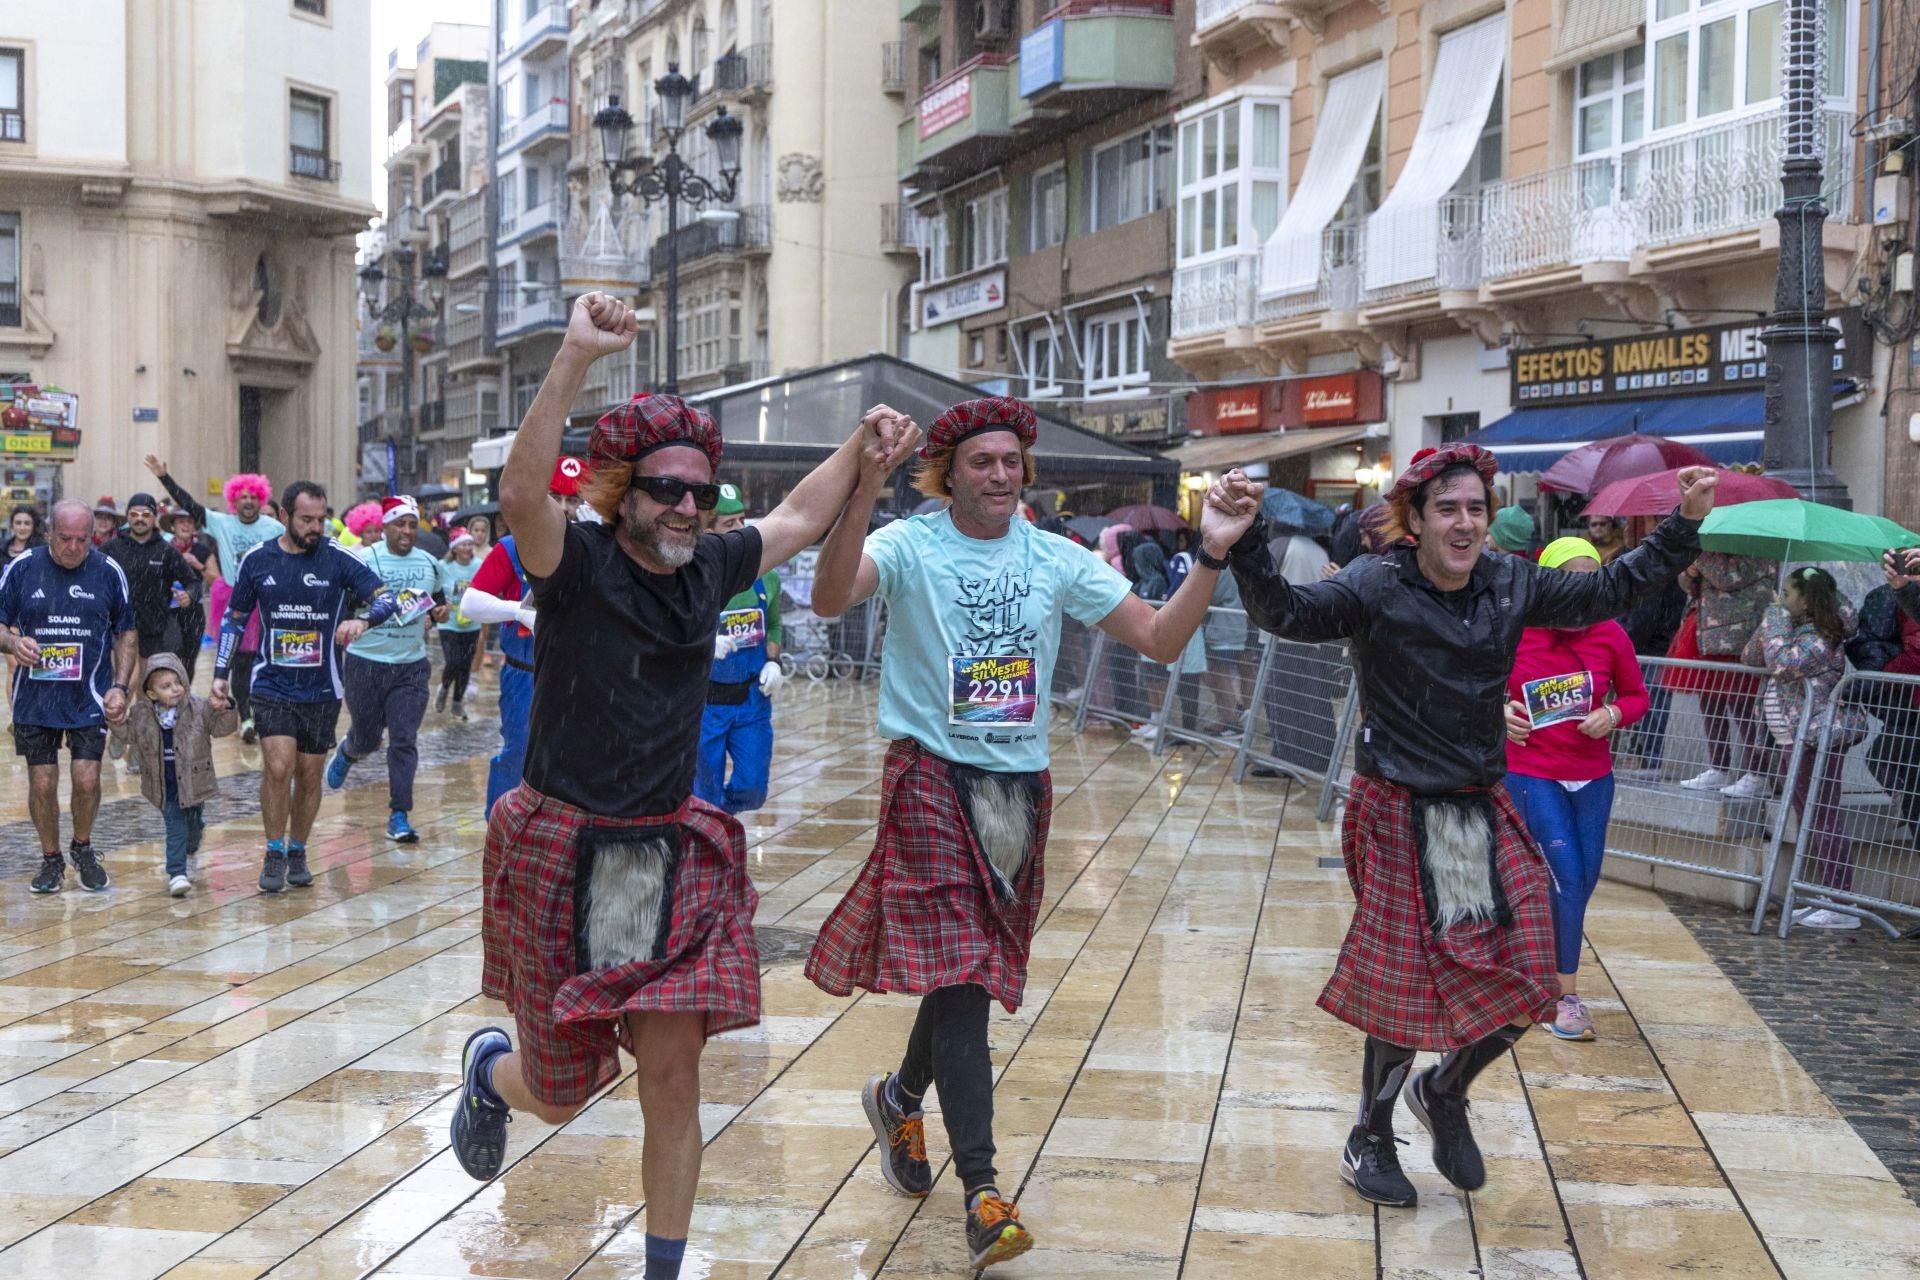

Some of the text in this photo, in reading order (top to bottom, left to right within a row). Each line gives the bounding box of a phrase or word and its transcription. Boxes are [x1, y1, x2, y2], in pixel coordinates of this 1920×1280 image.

[1517, 347, 1603, 383] EFECTOS
[1612, 333, 1711, 373] NAVALES
[9, 438, 47, 449] ONCE
[564, 462, 578, 472] M
[724, 487, 734, 497] L
[278, 604, 312, 612] SOLANO
[48, 615, 80, 624] SOLANO
[271, 612, 329, 620] RUNNING TEAM
[35, 628, 91, 637] RUNNING TEAM
[726, 622, 758, 637] 1824
[280, 642, 314, 655] 1445
[40, 656, 74, 669] 1630
[972, 659, 997, 672] SAN
[972, 660, 1029, 681] SILVESTRE
[968, 679, 1024, 702] 2291
[1539, 678, 1557, 690] SAN
[1539, 673, 1585, 696] SILVESTRE
[1540, 688, 1584, 711] 1365
